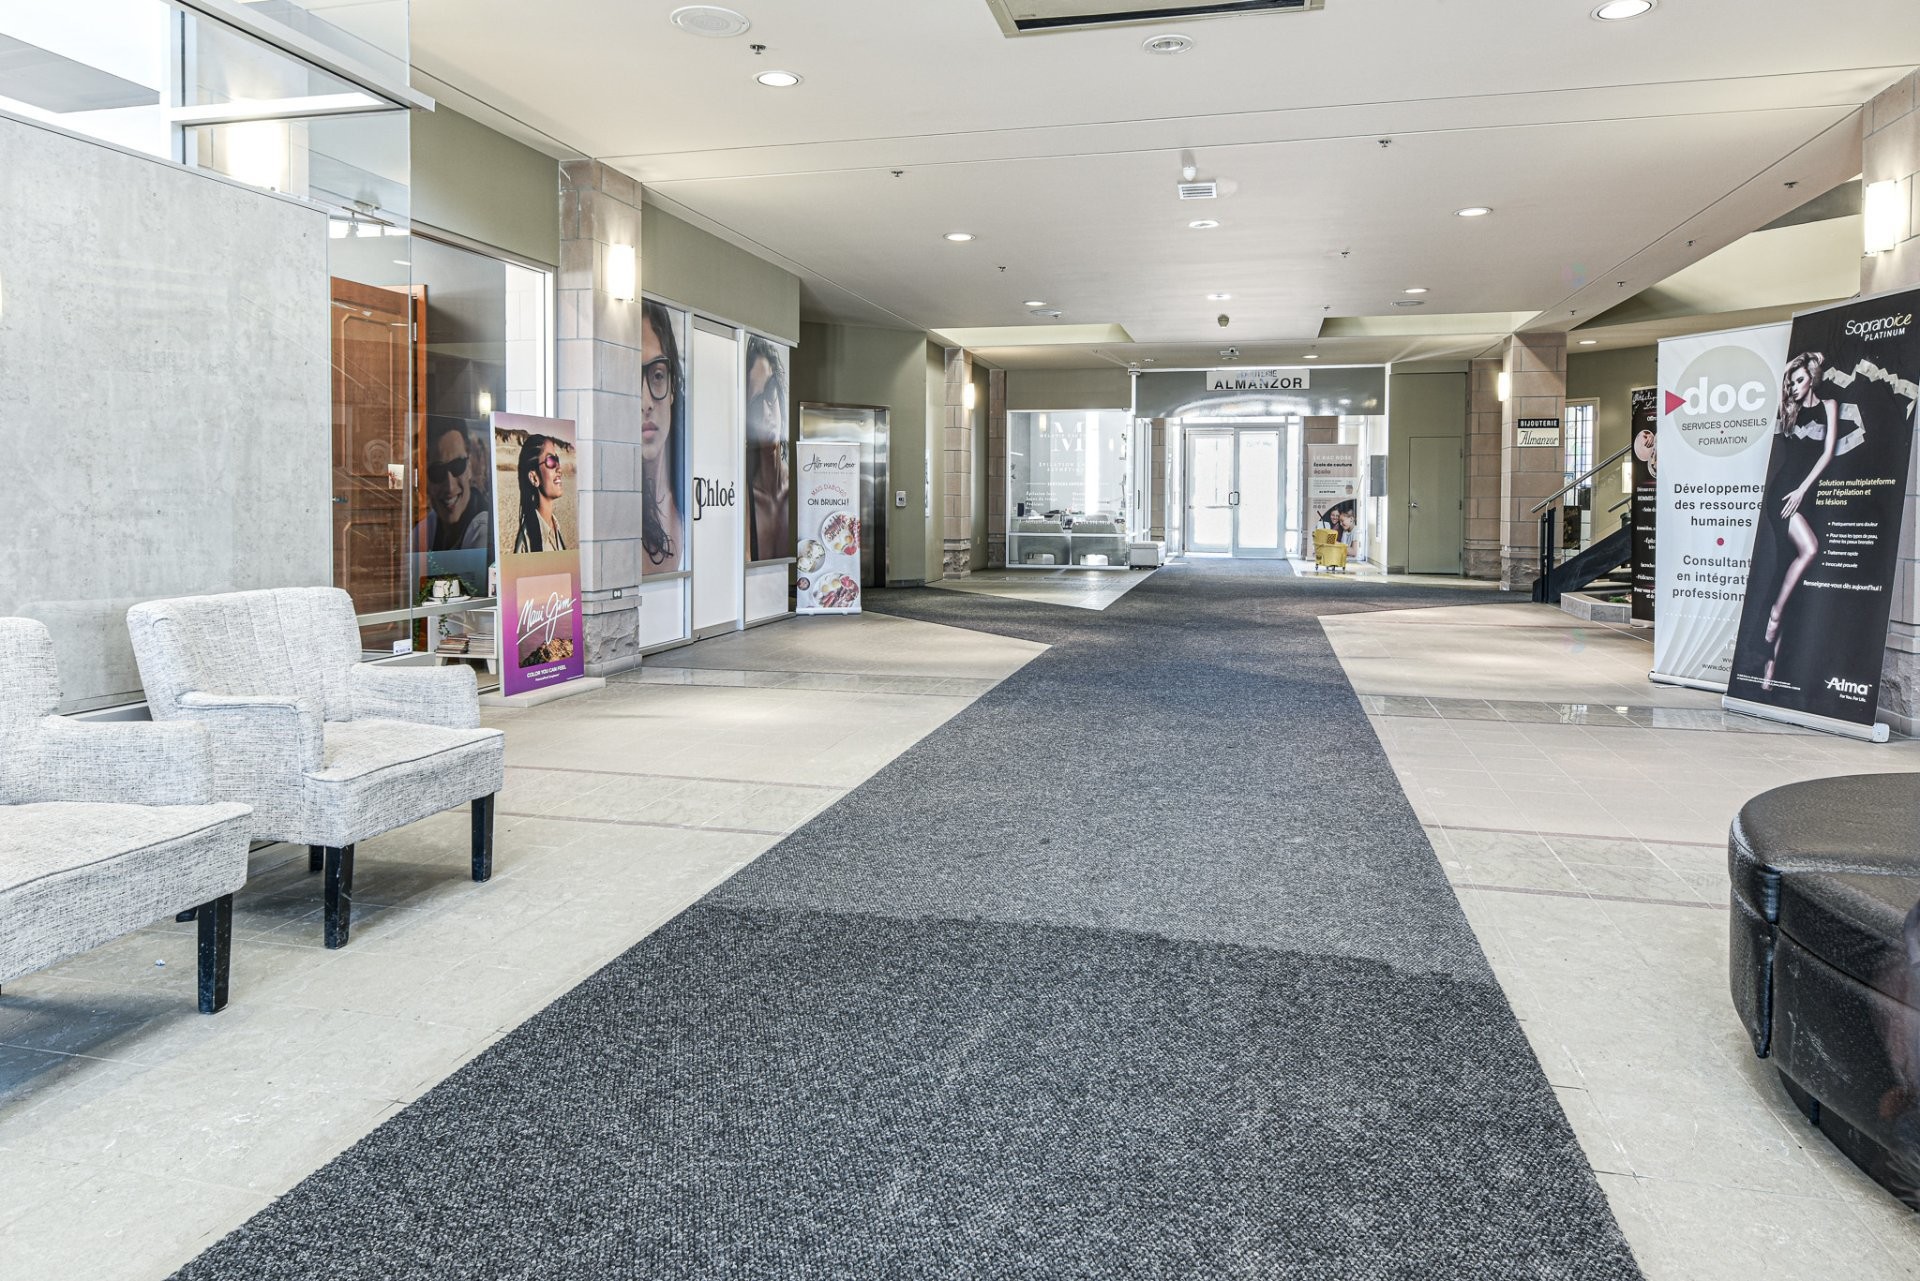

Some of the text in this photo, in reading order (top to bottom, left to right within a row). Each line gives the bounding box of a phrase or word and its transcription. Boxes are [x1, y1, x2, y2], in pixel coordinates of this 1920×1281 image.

[1864, 327, 1906, 342] PLATINUM
[1214, 377, 1303, 390] ALMANZOR
[1681, 376, 1766, 415] doc
[1519, 420, 1558, 428] BIJOUTERIE
[1681, 418, 1767, 431] SERVICES CONSEILS
[1519, 430, 1559, 446] Almanzor
[1698, 435, 1748, 446] FORMATION
[1818, 478, 1896, 487] Solution multiplateforme
[695, 477, 735, 507] Chloé
[1832, 489, 1864, 497] l'épilation
[807, 498, 819, 506] ON
[1674, 500, 1696, 510] des
[1691, 516, 1752, 527] humaines
[1677, 572, 1748, 586] en intégrat
[1803, 580, 1842, 589] Renseignez-vous
[516, 591, 577, 645] Maui Jim
[526, 670, 541, 678] COLOR
[1825, 676, 1869, 695] Alma
